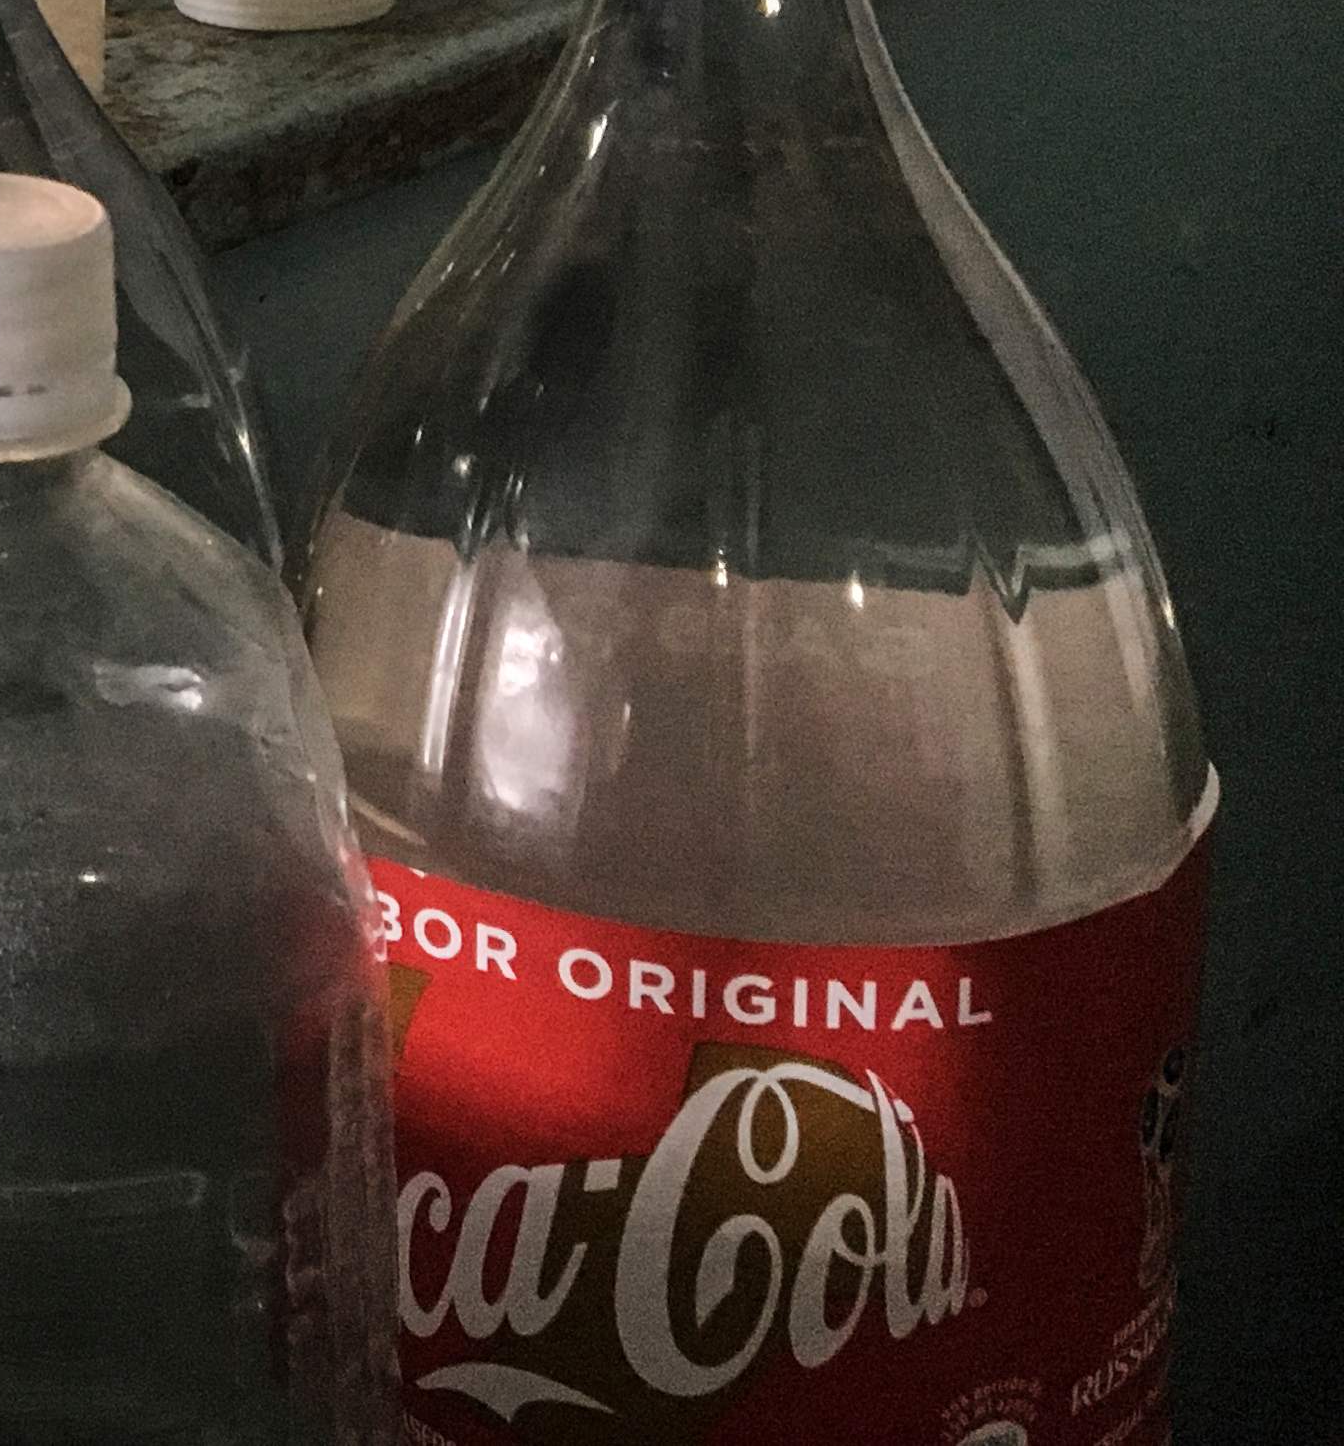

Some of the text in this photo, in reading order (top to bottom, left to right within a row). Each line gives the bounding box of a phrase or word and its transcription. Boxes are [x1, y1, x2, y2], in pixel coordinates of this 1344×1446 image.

[378, 890, 994, 1032] BOR ORIGINAL
[397, 1062, 970, 1397] ca-Cola
